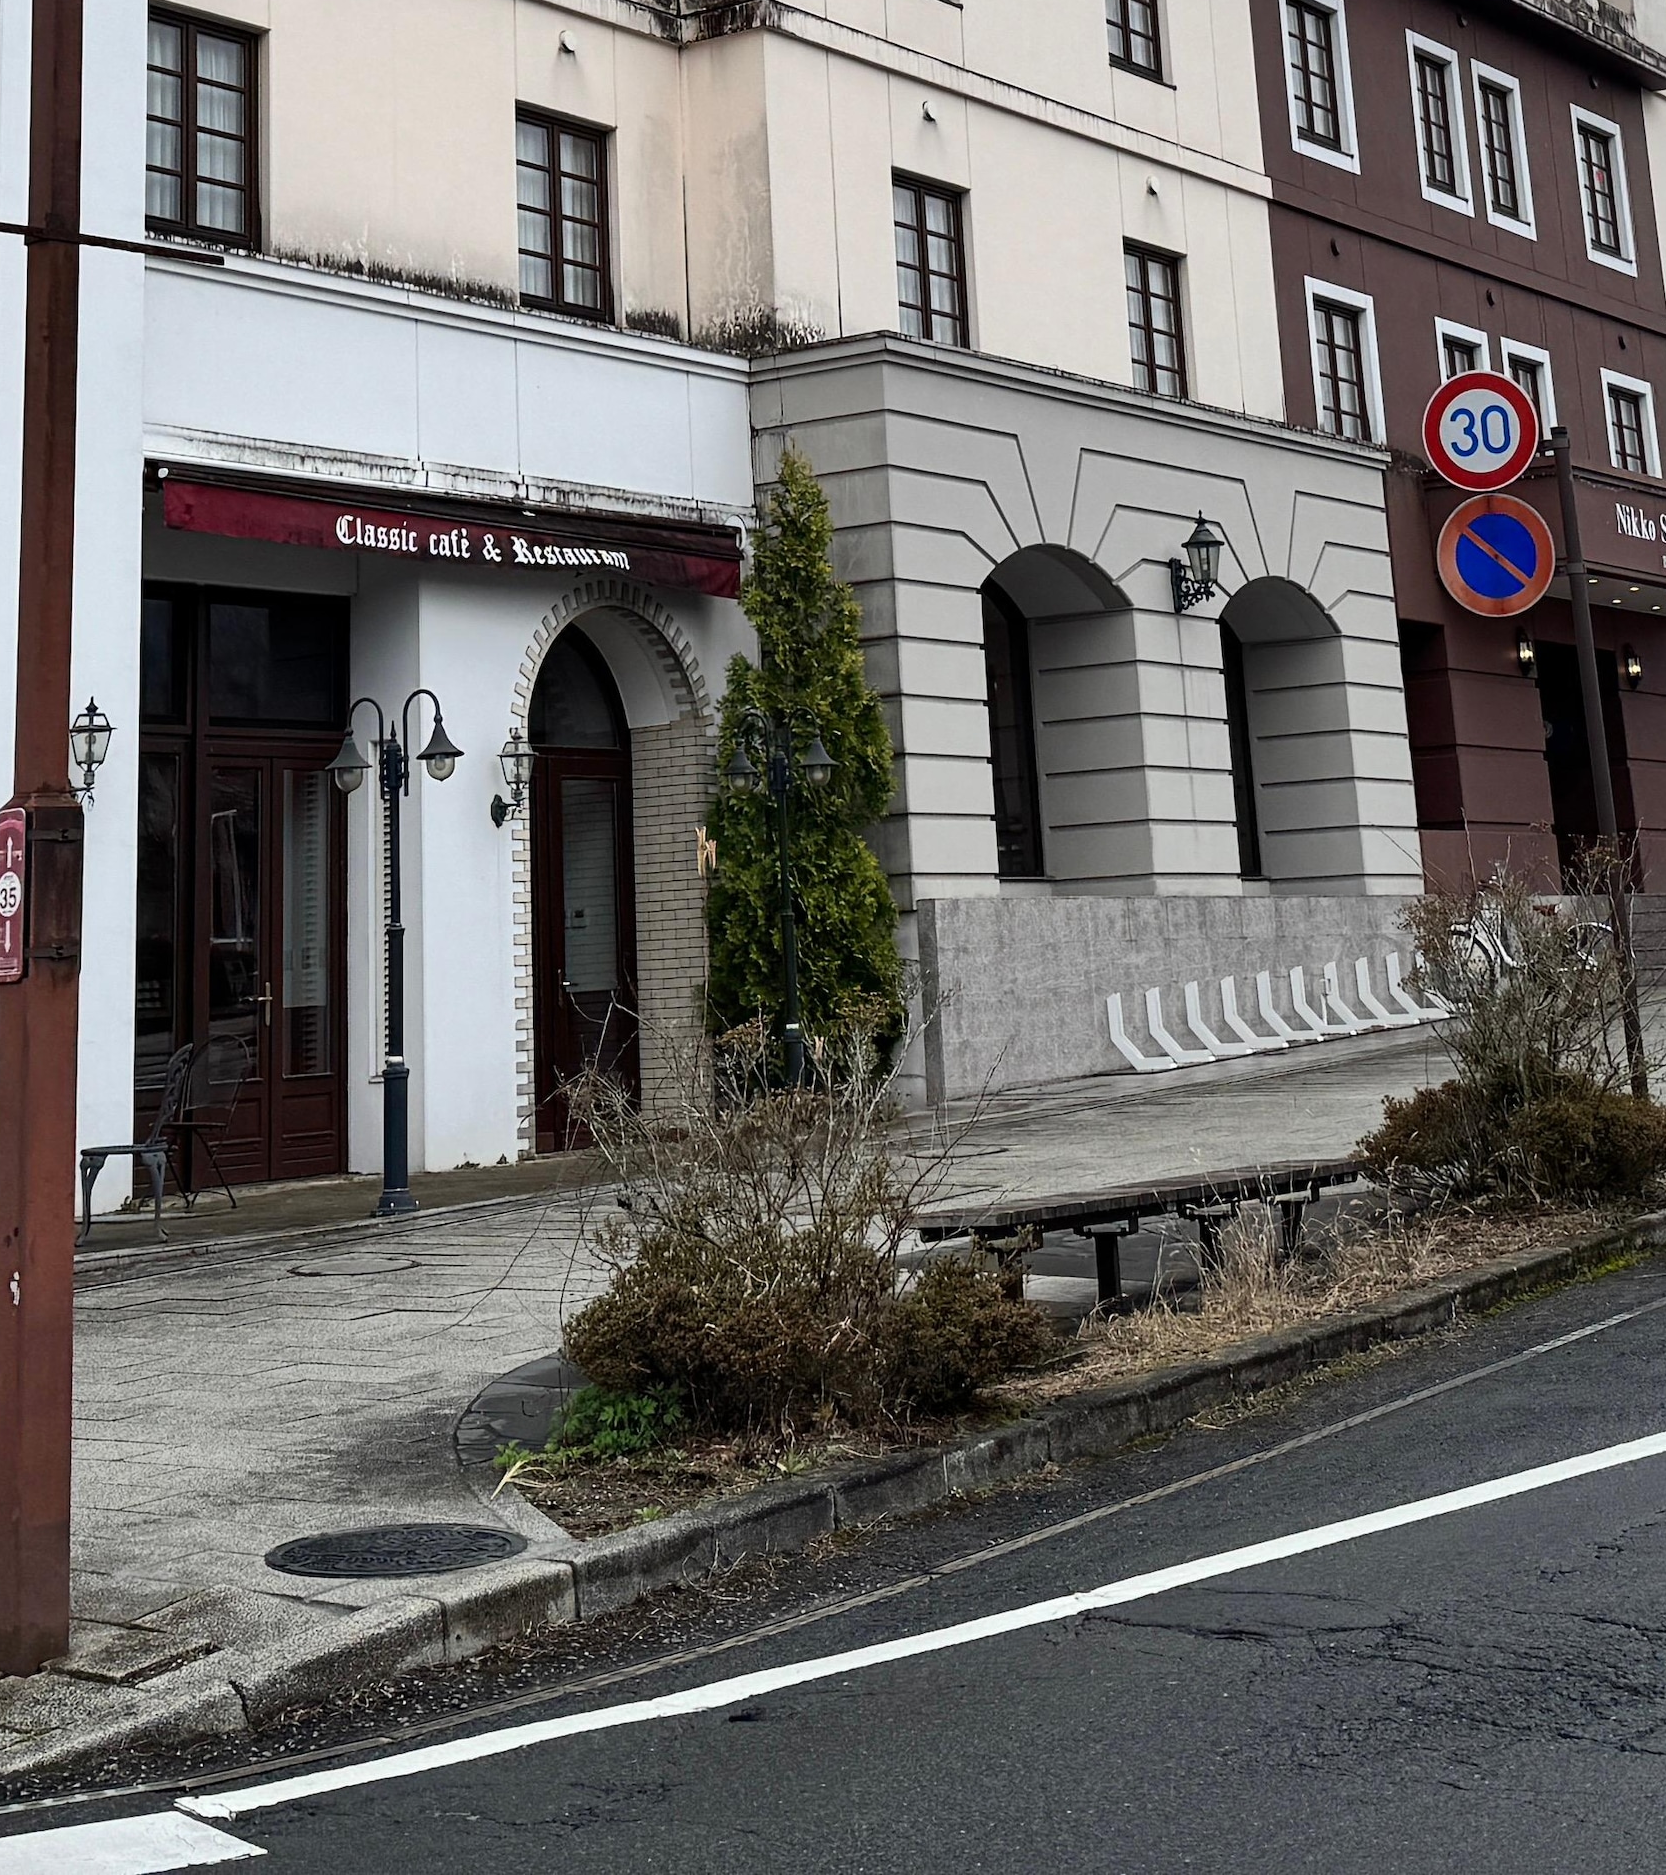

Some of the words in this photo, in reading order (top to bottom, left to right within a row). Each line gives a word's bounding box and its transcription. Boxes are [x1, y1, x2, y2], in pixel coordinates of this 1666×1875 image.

[1450, 404, 1511, 457] 30
[335, 514, 418, 553] Classic
[482, 533, 502, 563] &
[1615, 502, 1657, 542] Nikko
[0, 886, 17, 909] 35
